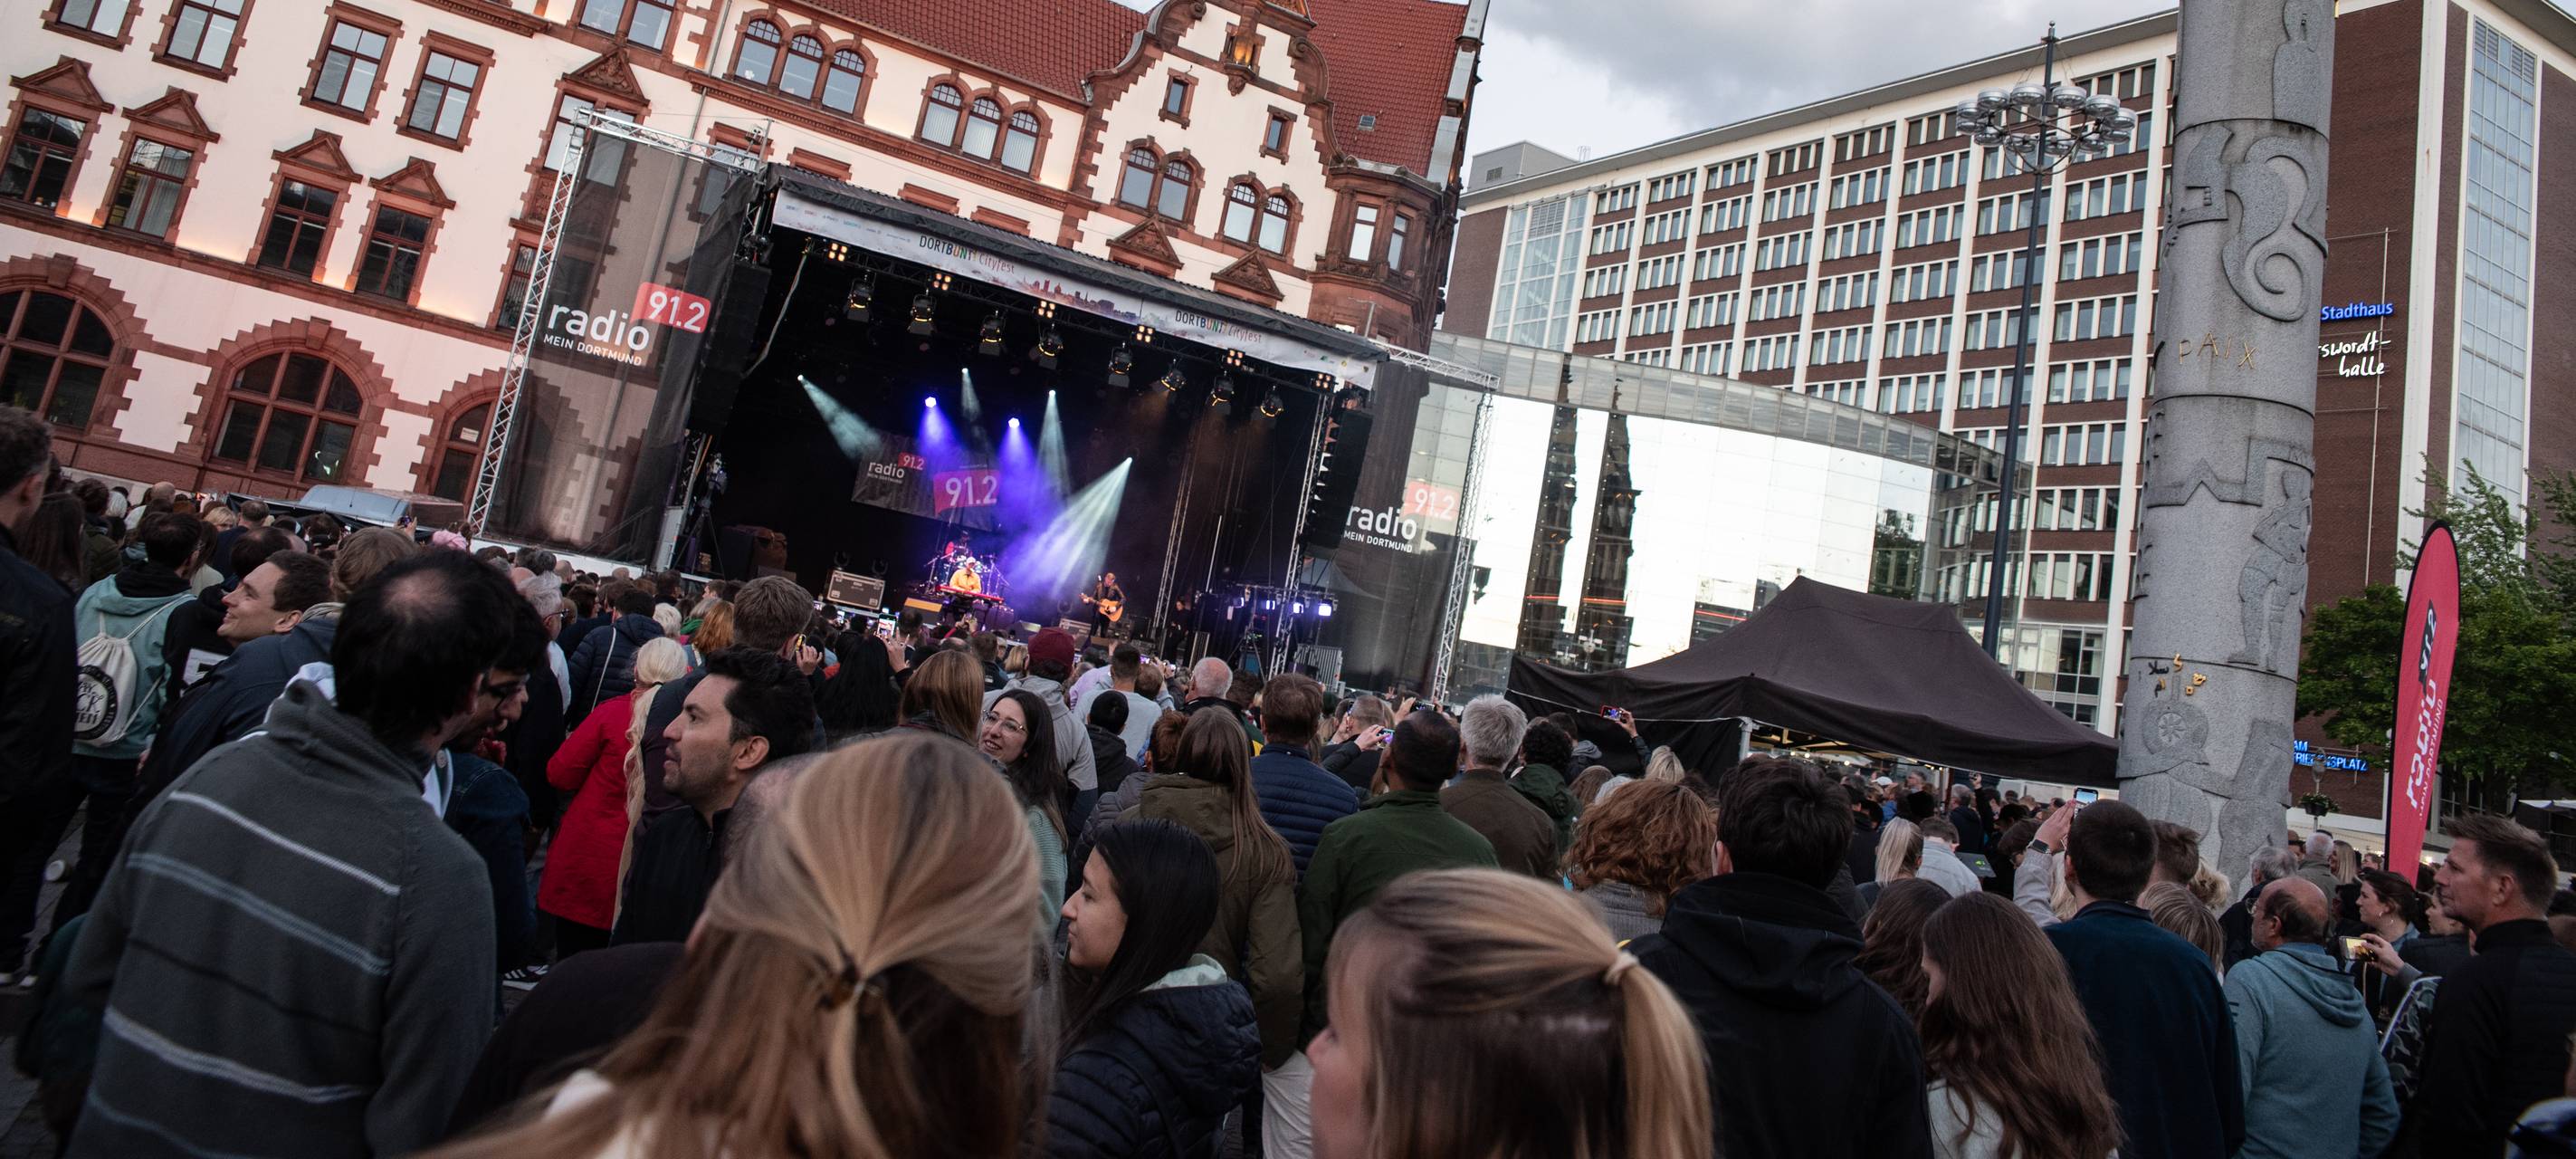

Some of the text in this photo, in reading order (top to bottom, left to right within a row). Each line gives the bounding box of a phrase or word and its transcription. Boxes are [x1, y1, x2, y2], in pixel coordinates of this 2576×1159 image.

[548, 303, 650, 351] radio
[649, 291, 706, 332] 91.2
[2321, 302, 2393, 321] Stadthaus
[543, 334, 643, 367] MEIN DORTMUND
[2179, 332, 2257, 370] PAIX
[2338, 355, 2385, 378] halle
[868, 461, 905, 479] radio
[902, 455, 925, 471] 91.2
[945, 474, 997, 507] 91.2
[1414, 488, 1455, 521] 91.2
[1345, 505, 1417, 541] radio
[1343, 530, 1413, 553] MEIN DORTMUND
